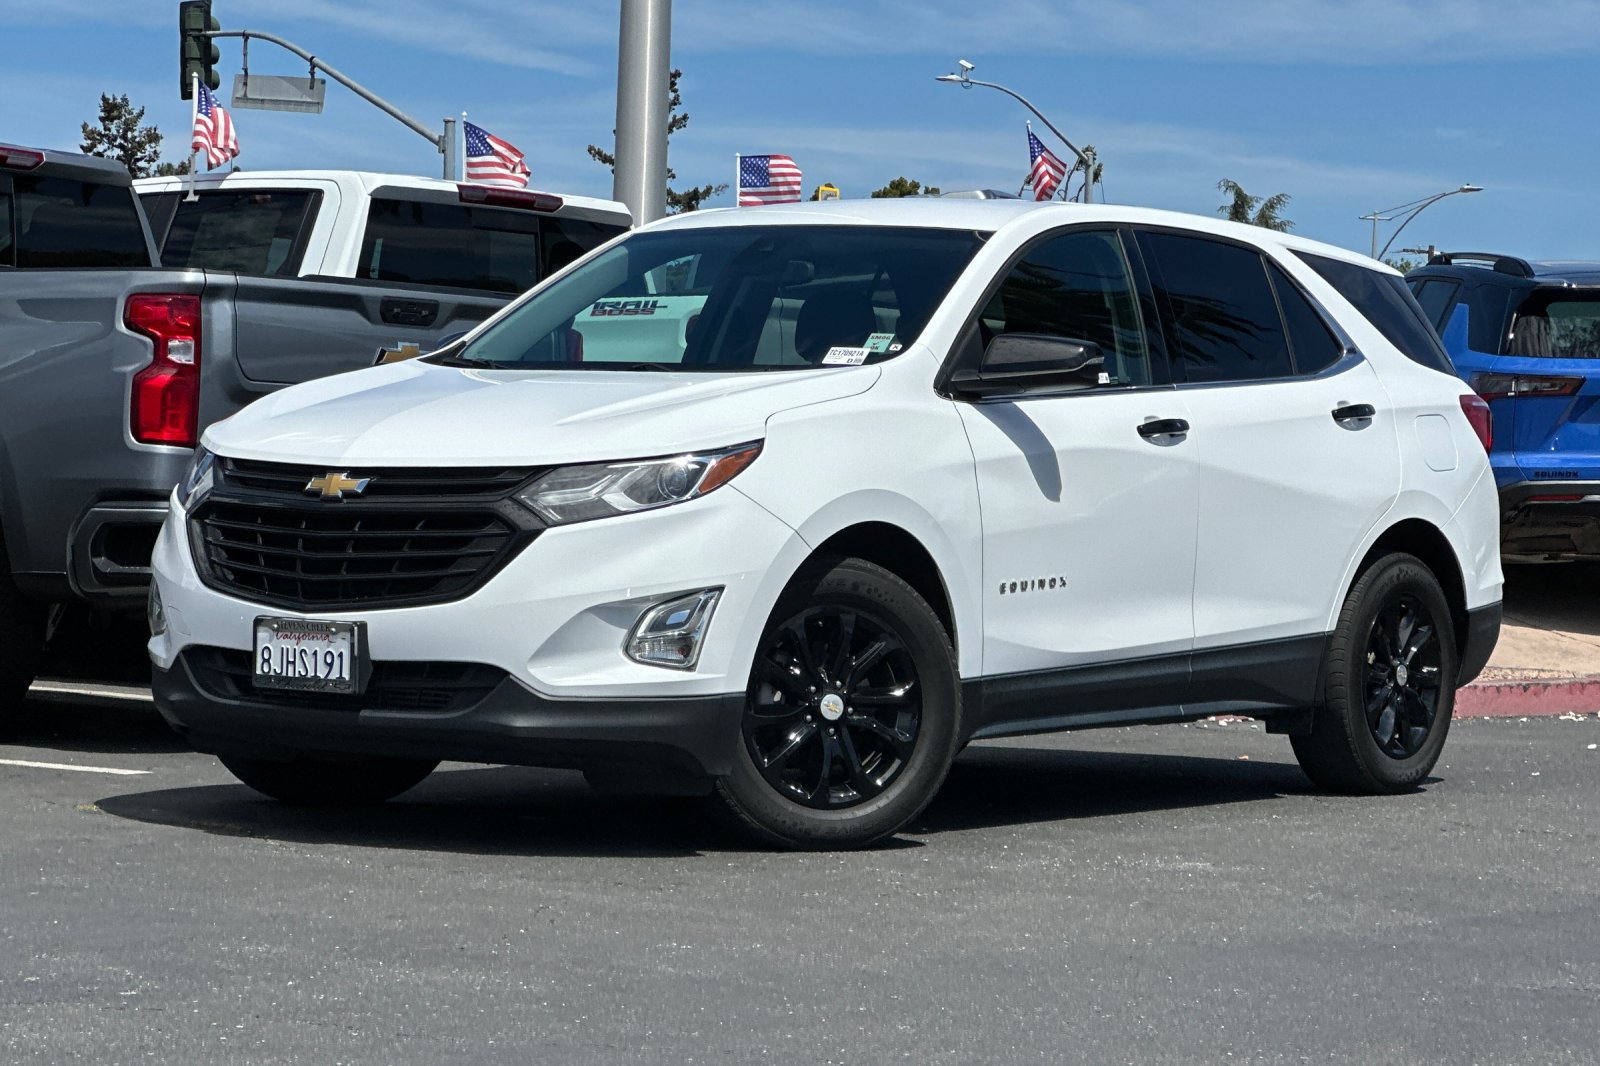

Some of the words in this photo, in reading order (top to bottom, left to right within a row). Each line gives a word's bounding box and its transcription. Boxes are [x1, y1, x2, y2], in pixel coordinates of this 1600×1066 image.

[591, 308, 656, 316] BOSS
[1534, 471, 1579, 479] EQUINOX
[999, 576, 1067, 595] EQUINOX
[277, 620, 305, 631] STEVENS
[306, 622, 331, 632] CREEK
[261, 646, 346, 679] 8JHS191
